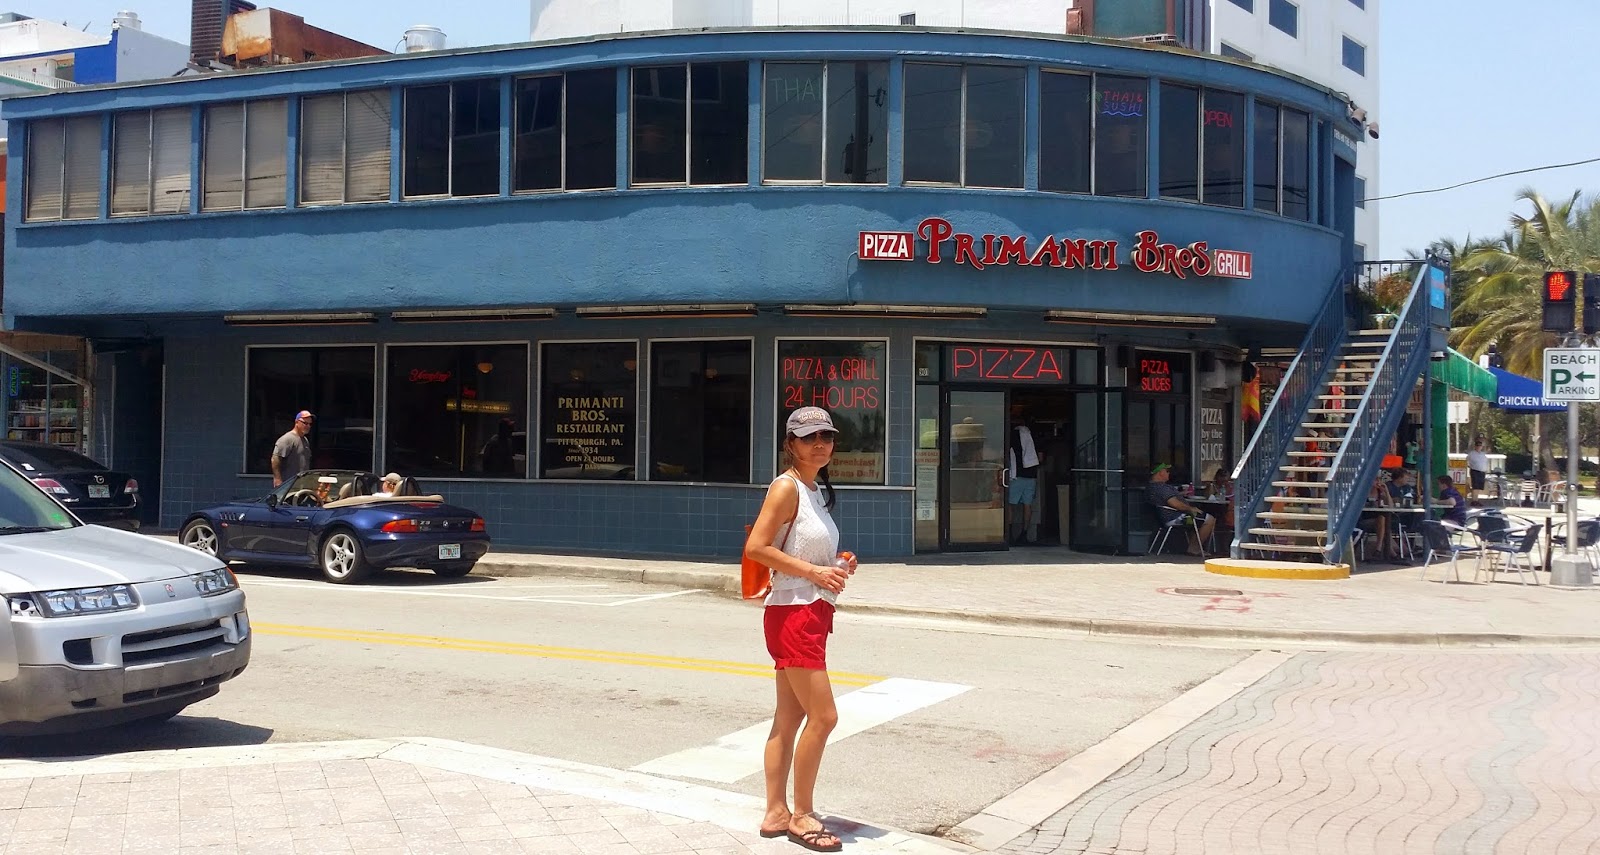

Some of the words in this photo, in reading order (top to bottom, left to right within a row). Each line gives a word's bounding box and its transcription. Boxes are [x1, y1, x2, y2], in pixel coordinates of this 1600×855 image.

[1103, 101, 1142, 112] SUSHI
[863, 234, 909, 259] PIZZA
[1216, 253, 1250, 278] GRILL
[953, 348, 1063, 380] PIZZA
[1550, 354, 1596, 365] BEACH
[783, 358, 824, 380] PIZZA
[827, 364, 838, 381] &
[841, 358, 880, 381] GRILL
[1141, 360, 1169, 375] PIZZA
[1141, 377, 1172, 391] SLICES
[558, 397, 624, 409] PRIMANTI
[785, 385, 805, 409] 24
[812, 385, 879, 409] HOURS
[1498, 396, 1540, 407] CHICKEN
[572, 410, 609, 421] BROS.
[1201, 407, 1223, 425] PIZZA
[556, 424, 625, 433] RESTAURANT
[1201, 428, 1210, 440] by
[1211, 428, 1222, 439] the
[557, 438, 608, 446] PITTSBURGH,
[611, 438, 624, 446] PA.
[582, 446, 599, 454] 1934
[1201, 443, 1223, 461] SLICE
[592, 455, 616, 463] HOURS
[833, 457, 876, 467] Breakfast
